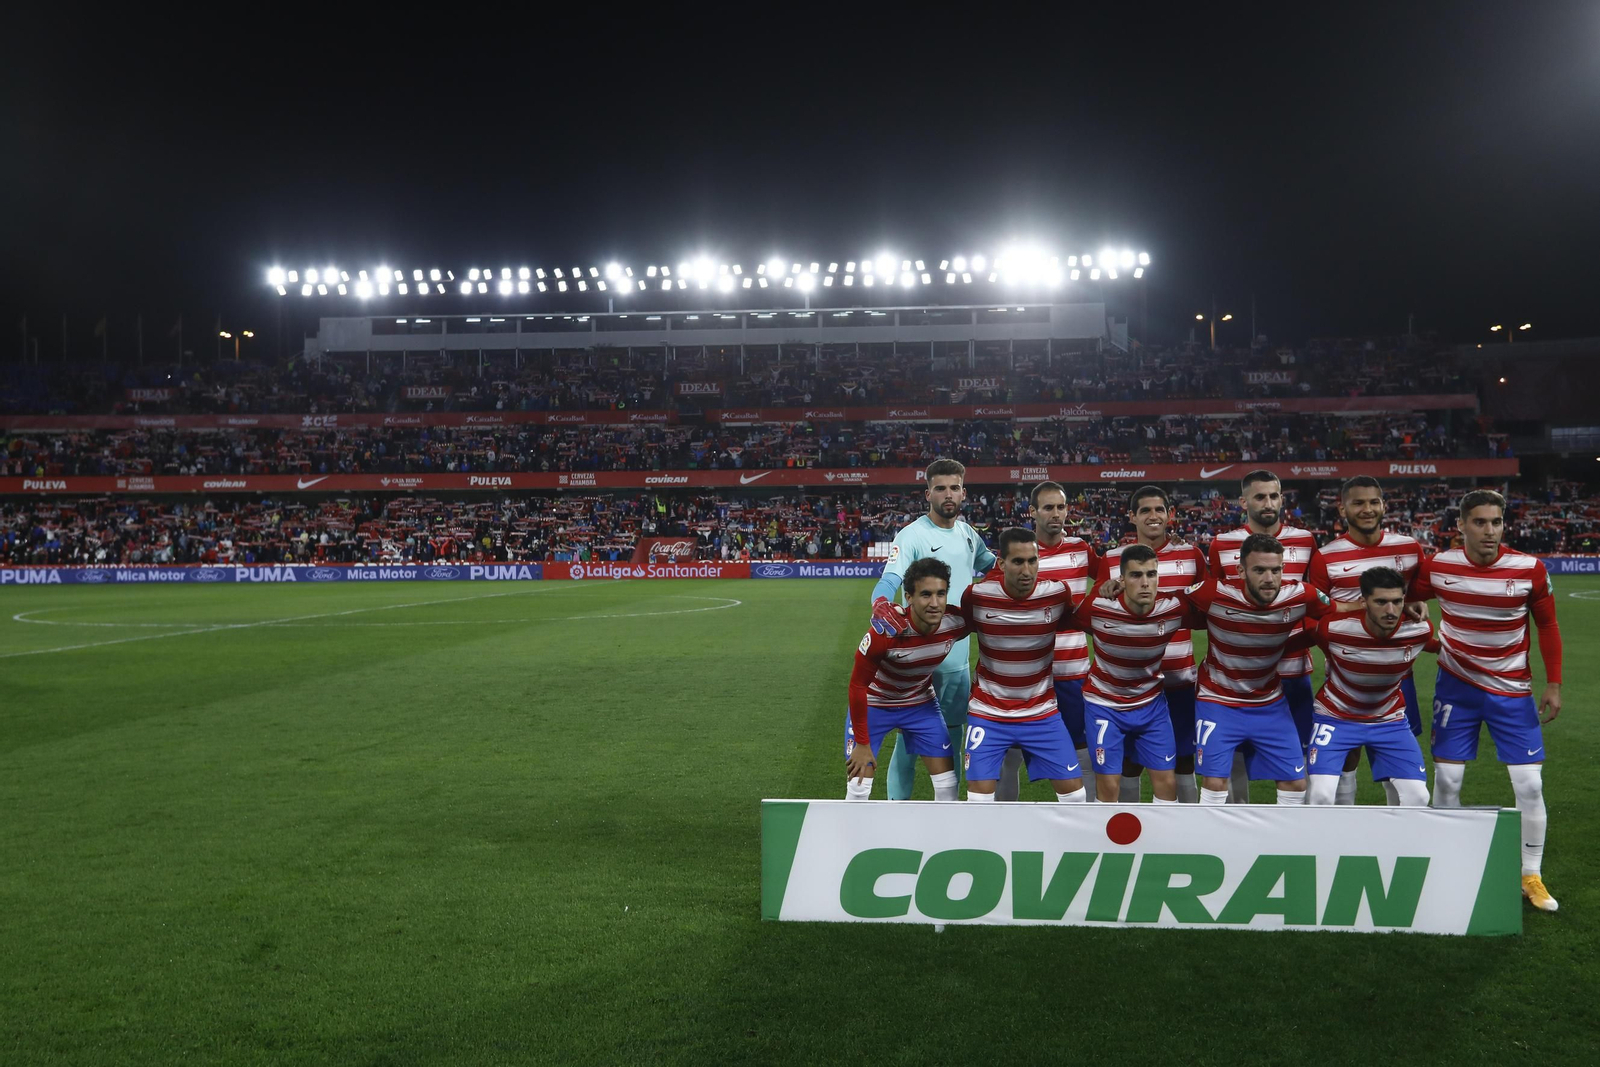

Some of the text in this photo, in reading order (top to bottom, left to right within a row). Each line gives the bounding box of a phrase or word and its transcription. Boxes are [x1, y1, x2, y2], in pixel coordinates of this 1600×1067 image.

[1248, 372, 1291, 381] IDEAL
[680, 383, 719, 392] IDEAL
[959, 378, 999, 388] IDEAL
[407, 387, 446, 397] IDEAL
[555, 414, 585, 422] CaixaBank
[729, 411, 760, 419] CaixaBank
[813, 410, 843, 419] CaixaBank
[897, 409, 928, 418] CaixaBank
[1100, 469, 1145, 479] COVIRAN
[1389, 463, 1437, 474] PULEVA
[203, 478, 246, 488] COVIRAN
[470, 475, 512, 486] PULEVA
[645, 474, 688, 483] COVIRAN
[23, 479, 67, 490] PULEVA
[650, 541, 694, 556] Coca-Cola
[586, 564, 723, 579] LaLiga Santander
[762, 564, 786, 576] Ford
[799, 565, 874, 577] Mica Motor
[1561, 561, 1595, 572] Mica
[1, 569, 62, 584] PUMA
[80, 571, 104, 581] Ford
[116, 570, 186, 581] Mica Motor
[196, 570, 218, 580] Ford
[236, 567, 297, 582] PUMA
[312, 569, 334, 579] Ford
[347, 569, 417, 580] Mica Motor
[430, 568, 453, 578] Ford
[470, 565, 533, 580] PUMA
[966, 725, 986, 750] 19
[1095, 719, 1109, 745] 7
[1195, 719, 1217, 746] 17
[1309, 723, 1335, 747] 15
[839, 812, 1430, 928] COVIRAN
